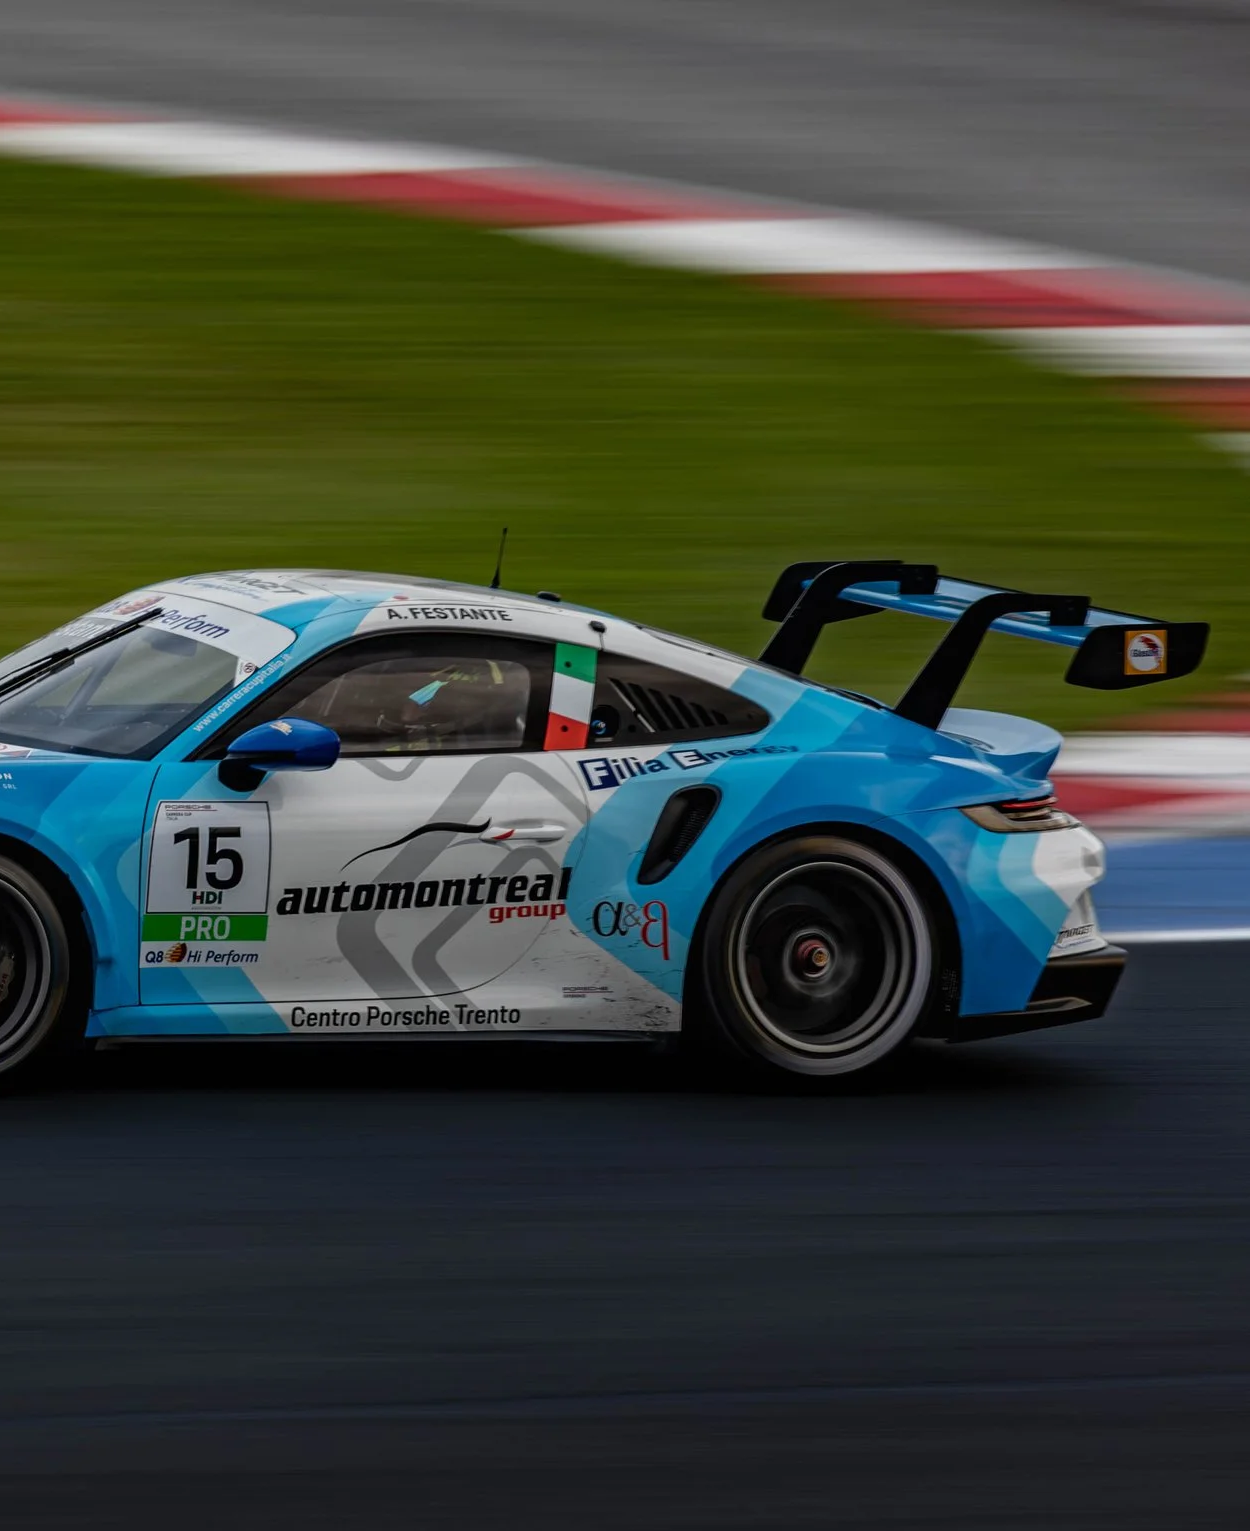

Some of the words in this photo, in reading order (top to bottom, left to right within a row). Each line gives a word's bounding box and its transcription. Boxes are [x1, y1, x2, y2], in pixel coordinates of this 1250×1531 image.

[161, 608, 231, 640] Perform
[387, 607, 409, 621] A.
[412, 608, 512, 622] FESTANTE
[192, 652, 293, 733] www.carreracupitalia.it
[667, 748, 800, 770] Energy
[173, 827, 243, 890] 15
[192, 891, 223, 904] HDI
[276, 866, 572, 915] automontreal
[489, 904, 565, 923] group
[180, 916, 231, 940] PRO
[145, 951, 164, 964] Q8
[187, 950, 202, 962] Hi
[205, 950, 259, 965] Perform
[291, 1006, 360, 1026] Centro
[367, 1007, 449, 1026] Porsche
[456, 1004, 520, 1024] Trento
